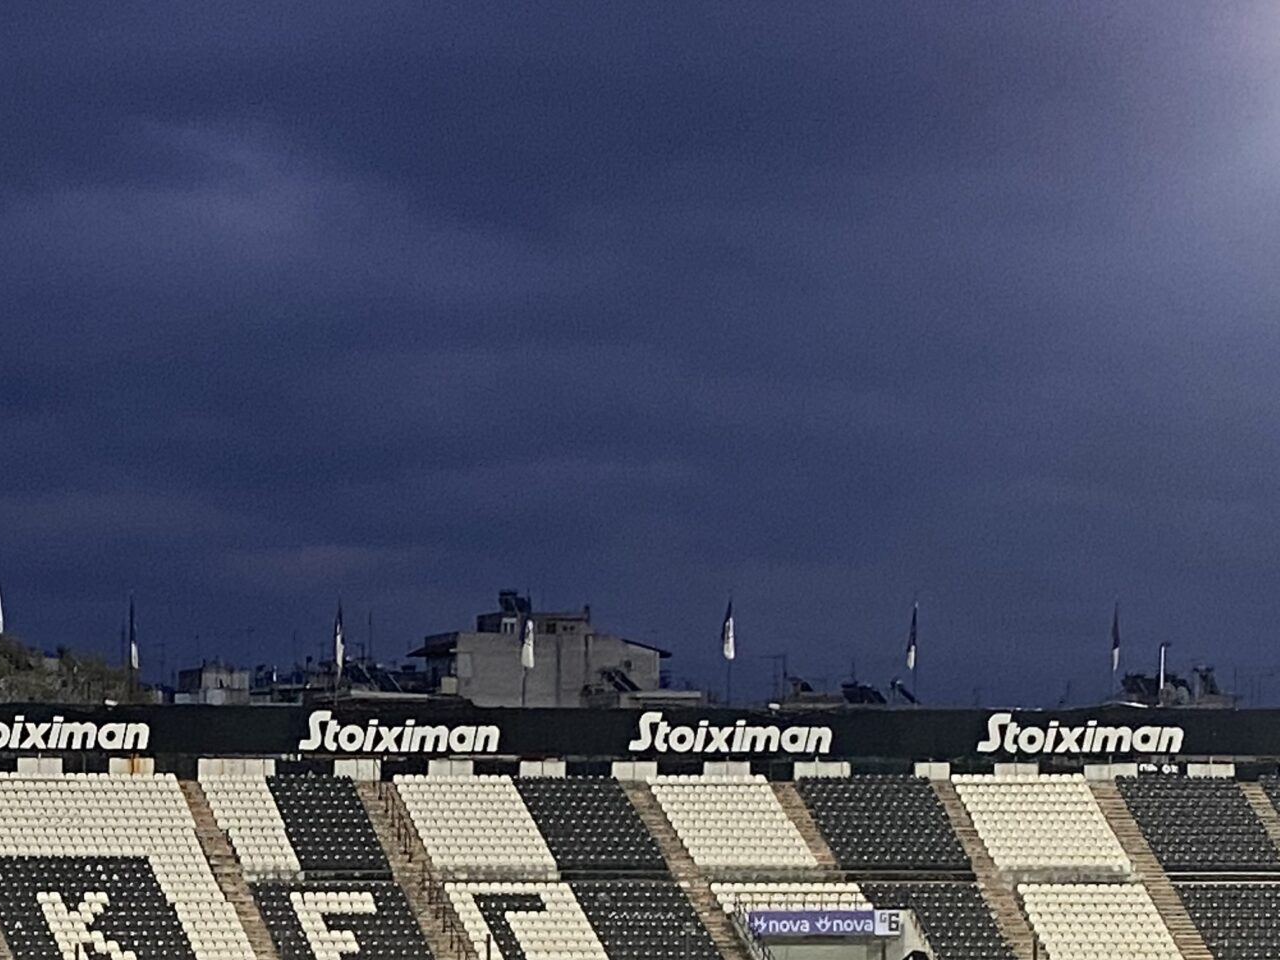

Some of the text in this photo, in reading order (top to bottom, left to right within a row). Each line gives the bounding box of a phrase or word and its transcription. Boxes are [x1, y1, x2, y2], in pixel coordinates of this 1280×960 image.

[298, 710, 500, 753] Stoiximan
[628, 711, 833, 754] Stoiximan
[976, 713, 1184, 754] Stoiximan
[769, 917, 810, 933] nova
[833, 917, 874, 932] nova
